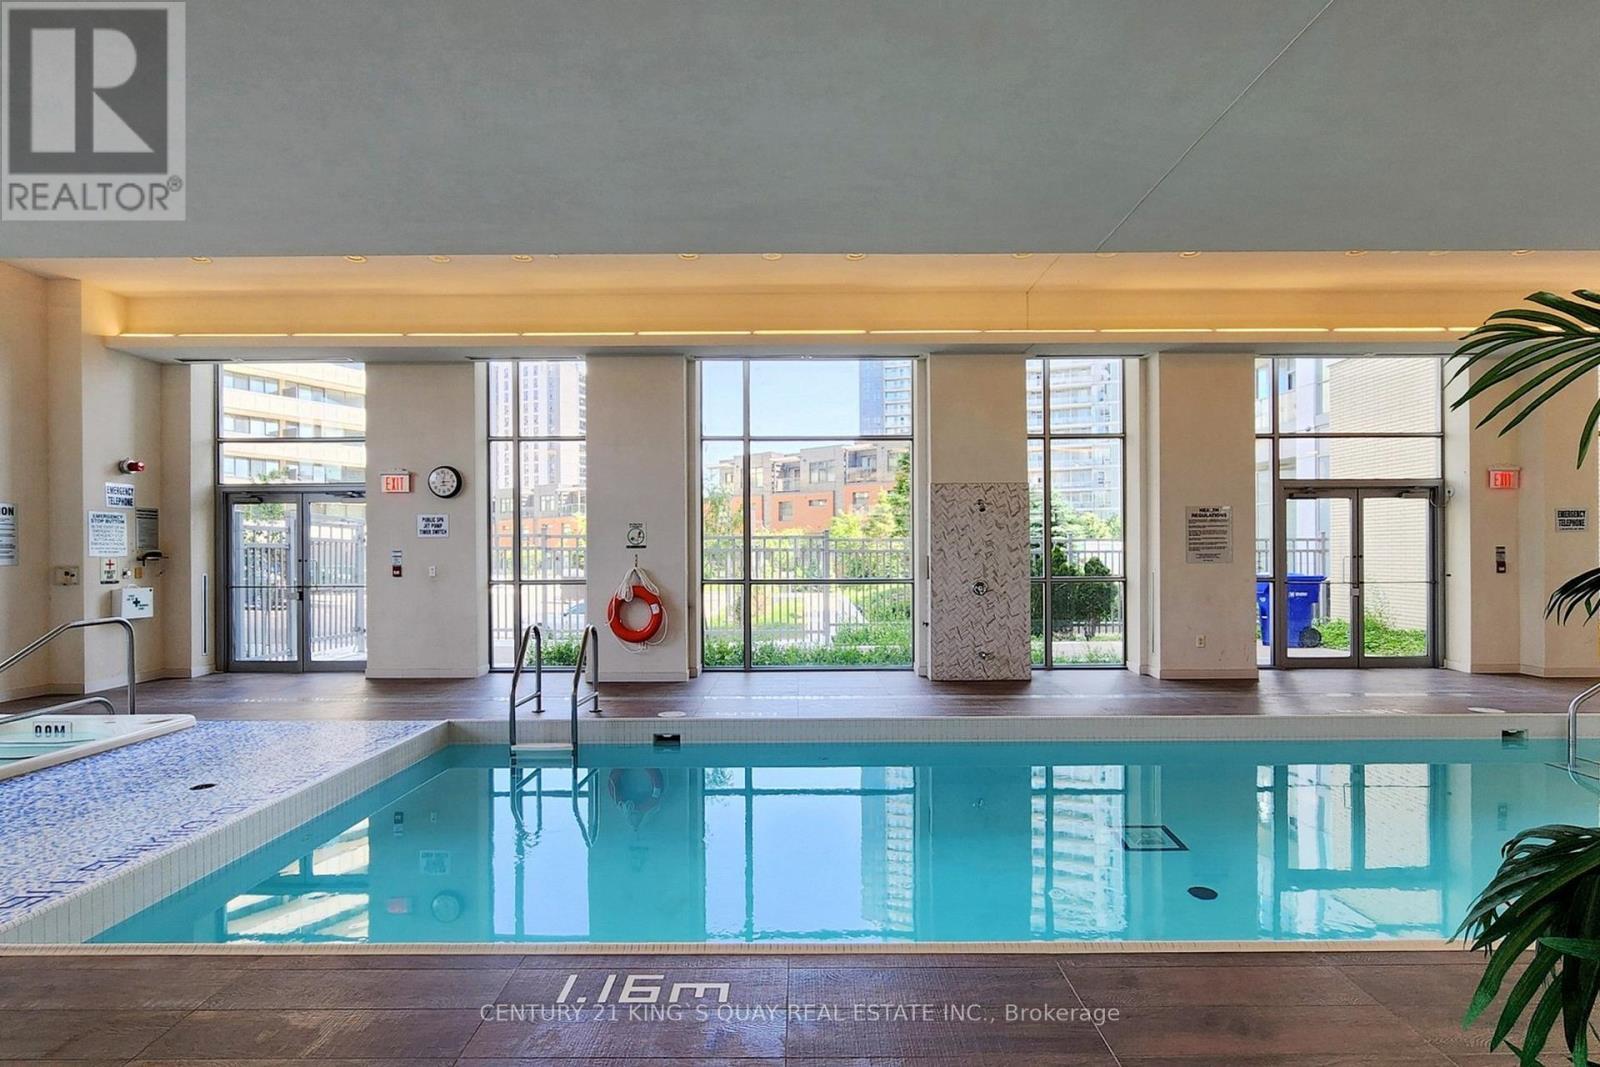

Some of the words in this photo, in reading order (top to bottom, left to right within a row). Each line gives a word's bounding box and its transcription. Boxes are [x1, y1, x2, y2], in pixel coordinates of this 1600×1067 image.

[385, 476, 404, 491] EXIT
[1494, 472, 1512, 487] EXIT
[106, 485, 134, 496] EMERGENCY
[107, 496, 134, 507] TELEPHONE
[1557, 510, 1586, 518] EMERGENCY
[1558, 519, 1585, 527] TELEPHONE
